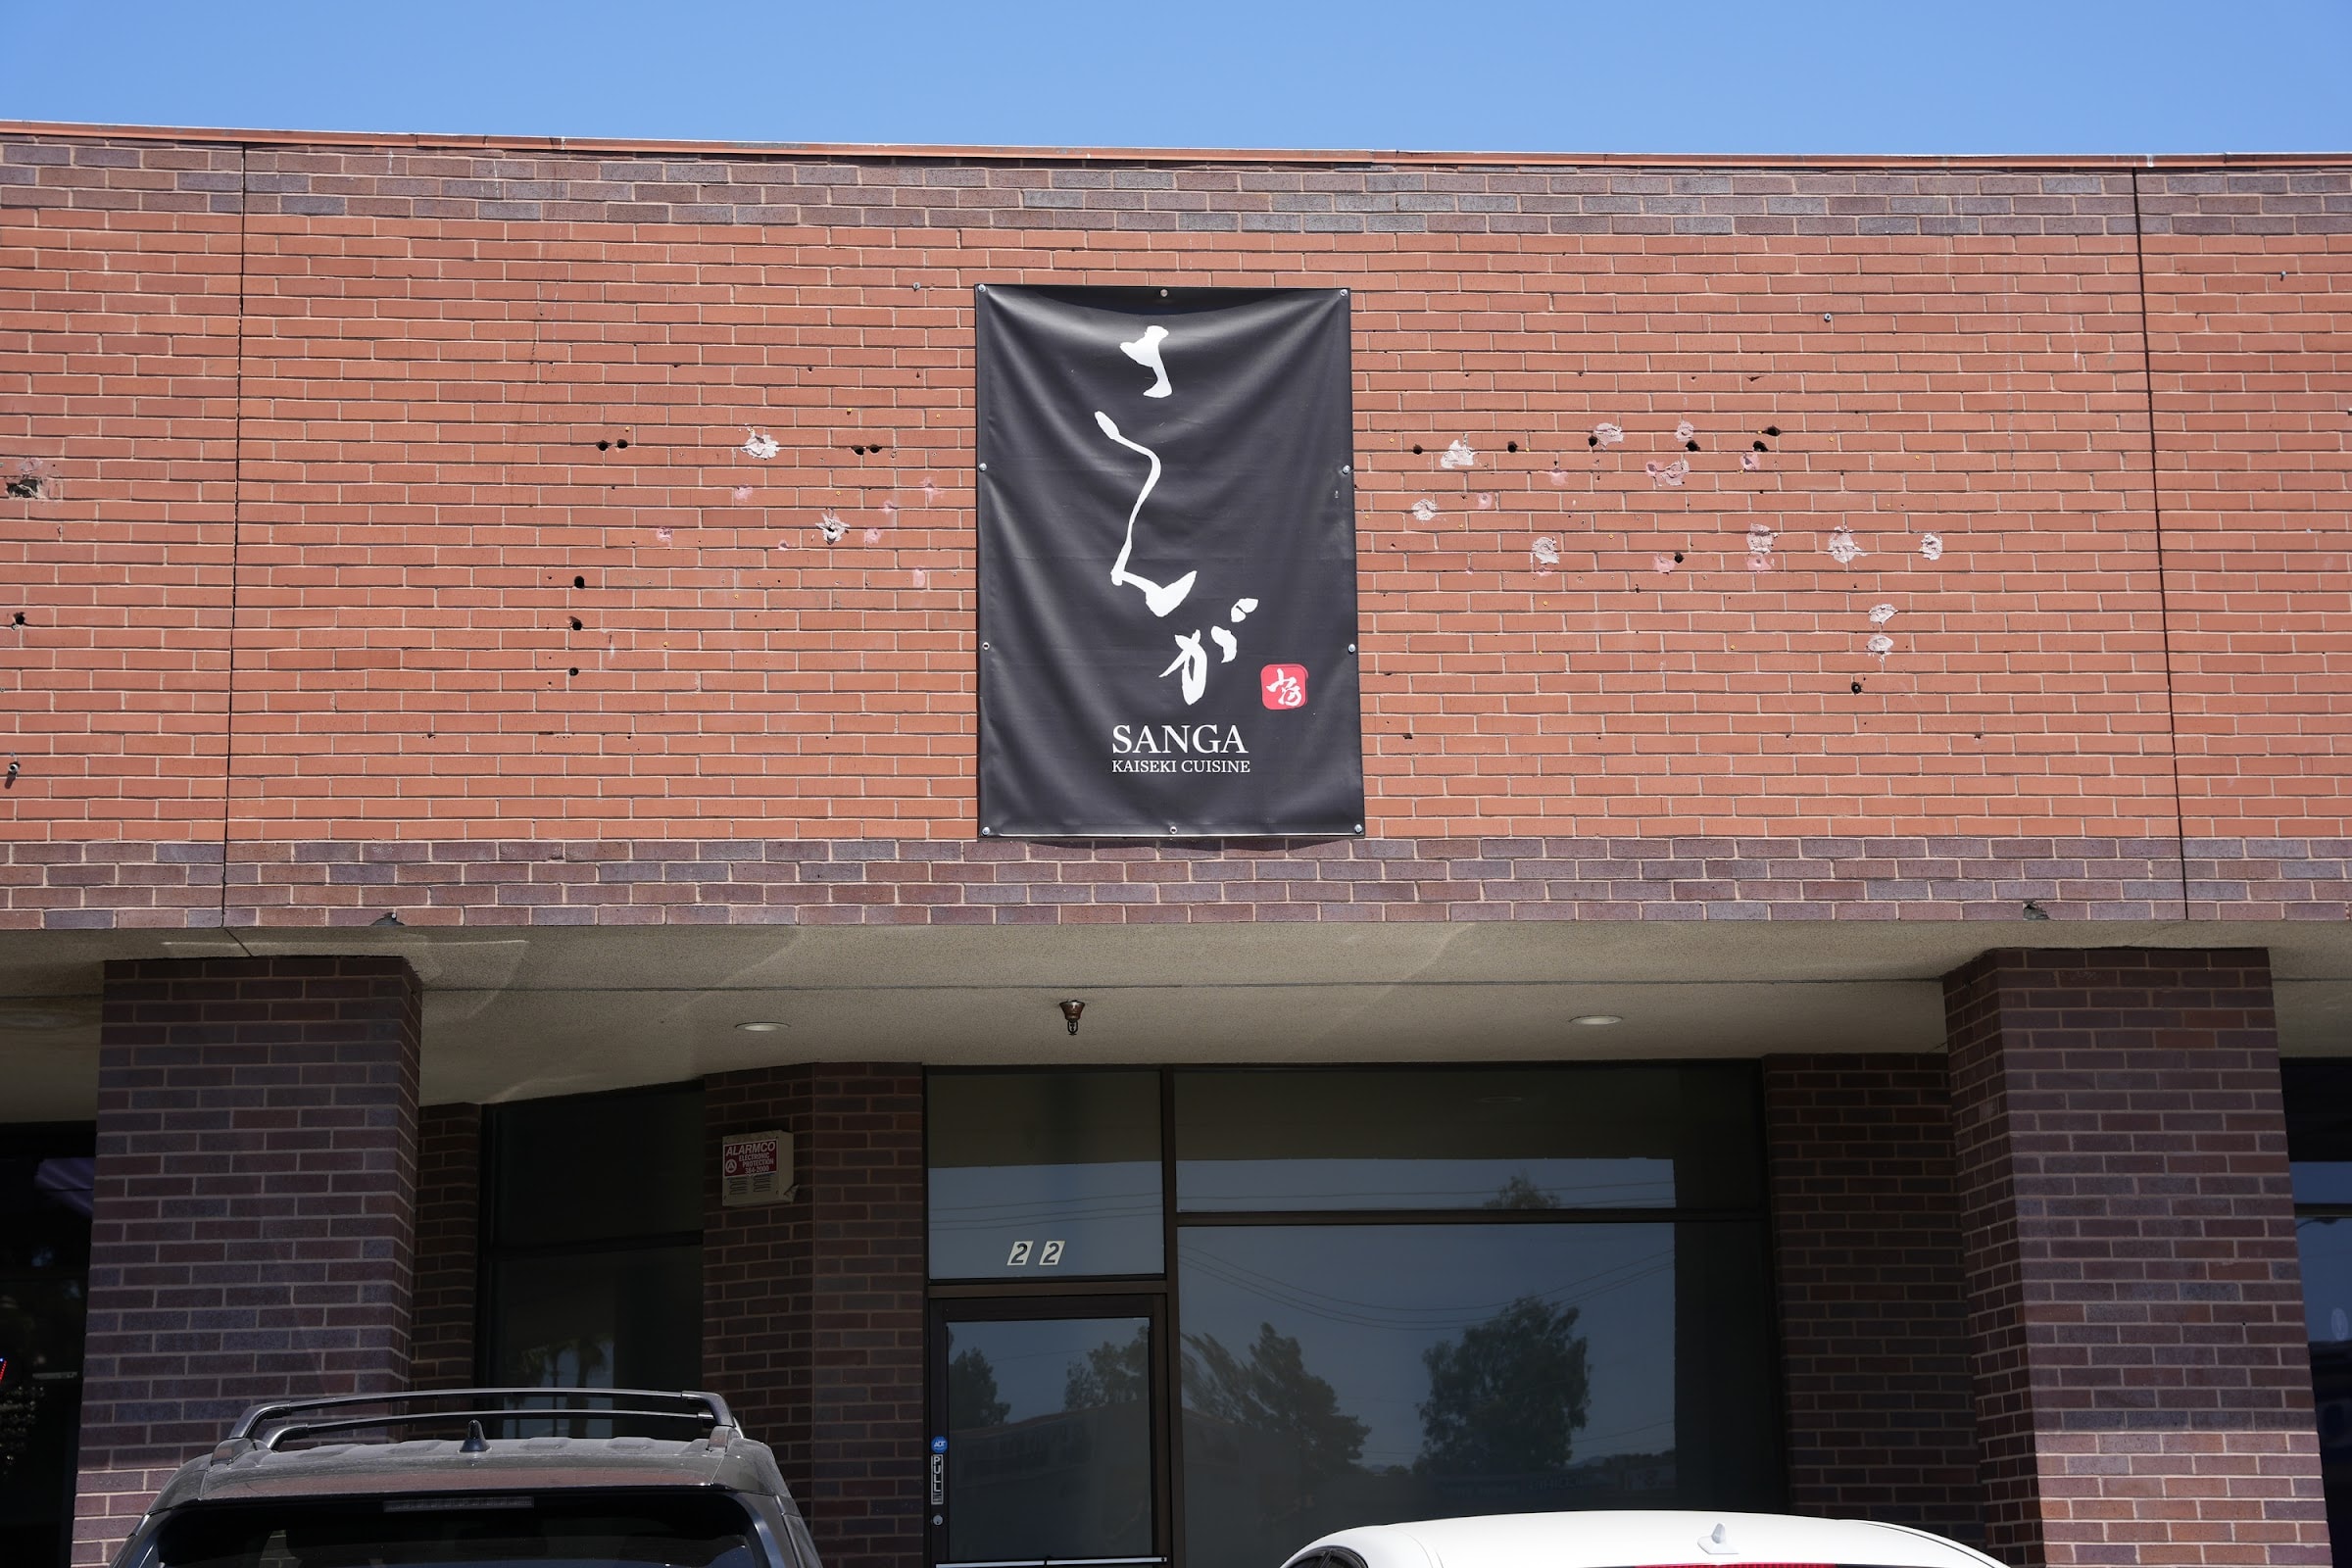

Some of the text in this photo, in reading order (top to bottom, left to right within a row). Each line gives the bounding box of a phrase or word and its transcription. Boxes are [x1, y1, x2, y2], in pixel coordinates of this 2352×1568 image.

[1111, 724, 1250, 754] SANGA
[1111, 760, 1250, 773] KAISEKI CUISINE
[726, 1141, 775, 1156] ALARMCO
[739, 1152, 770, 1162] ELECTRONIC
[743, 1158, 774, 1168] PROTECTION
[933, 1456, 942, 1493] PULL
